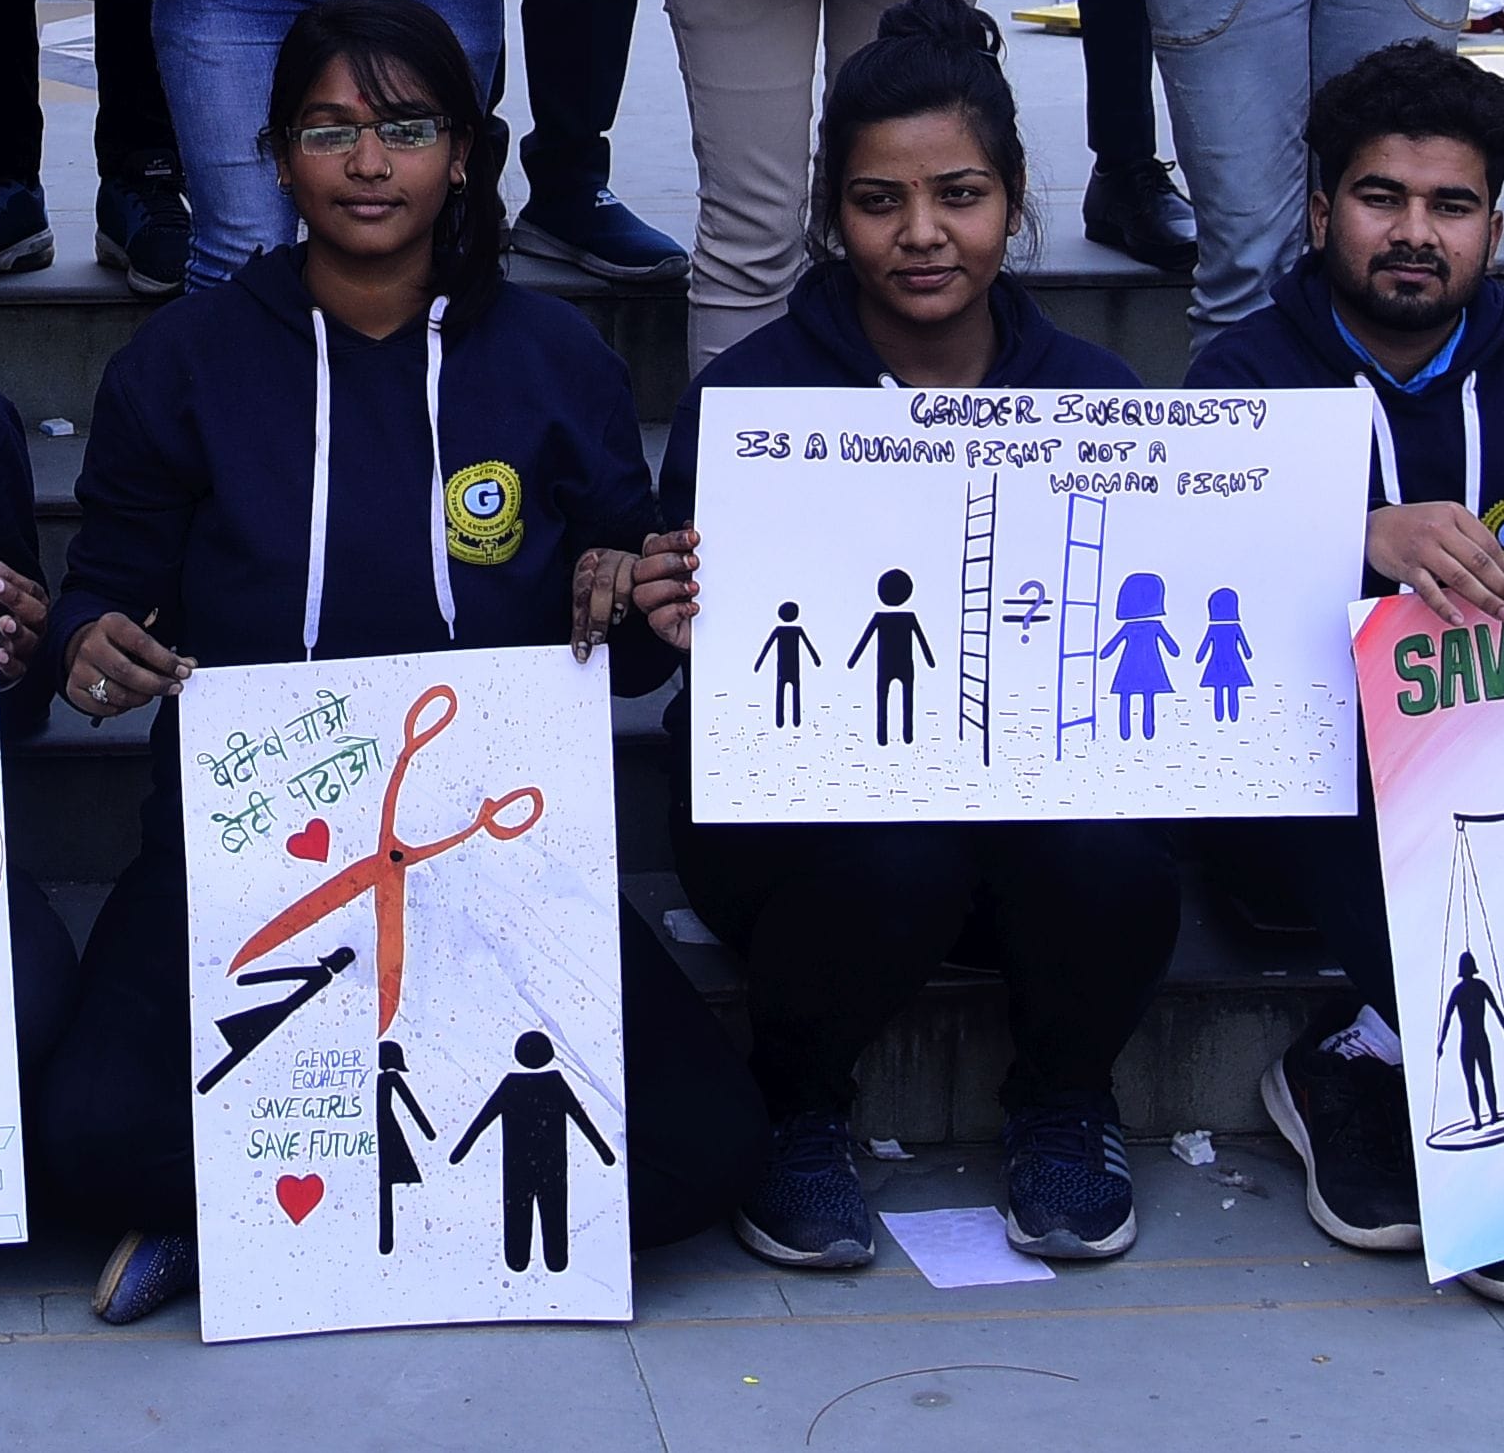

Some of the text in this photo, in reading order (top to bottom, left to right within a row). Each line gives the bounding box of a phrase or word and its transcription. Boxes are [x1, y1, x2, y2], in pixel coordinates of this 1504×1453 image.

[910, 392, 1269, 430] GENDER INEQUALITY
[735, 430, 1168, 468] IS A HUMAN FIGHT NOT A
[464, 480, 501, 516] G
[1049, 468, 1270, 498] WOMAN FIGHT
[293, 1049, 365, 1070] GENDER
[291, 1067, 370, 1091] EQUALITY
[251, 1095, 363, 1120] SAVE GIRLS
[246, 1129, 378, 1160] SAVE FUTURE
